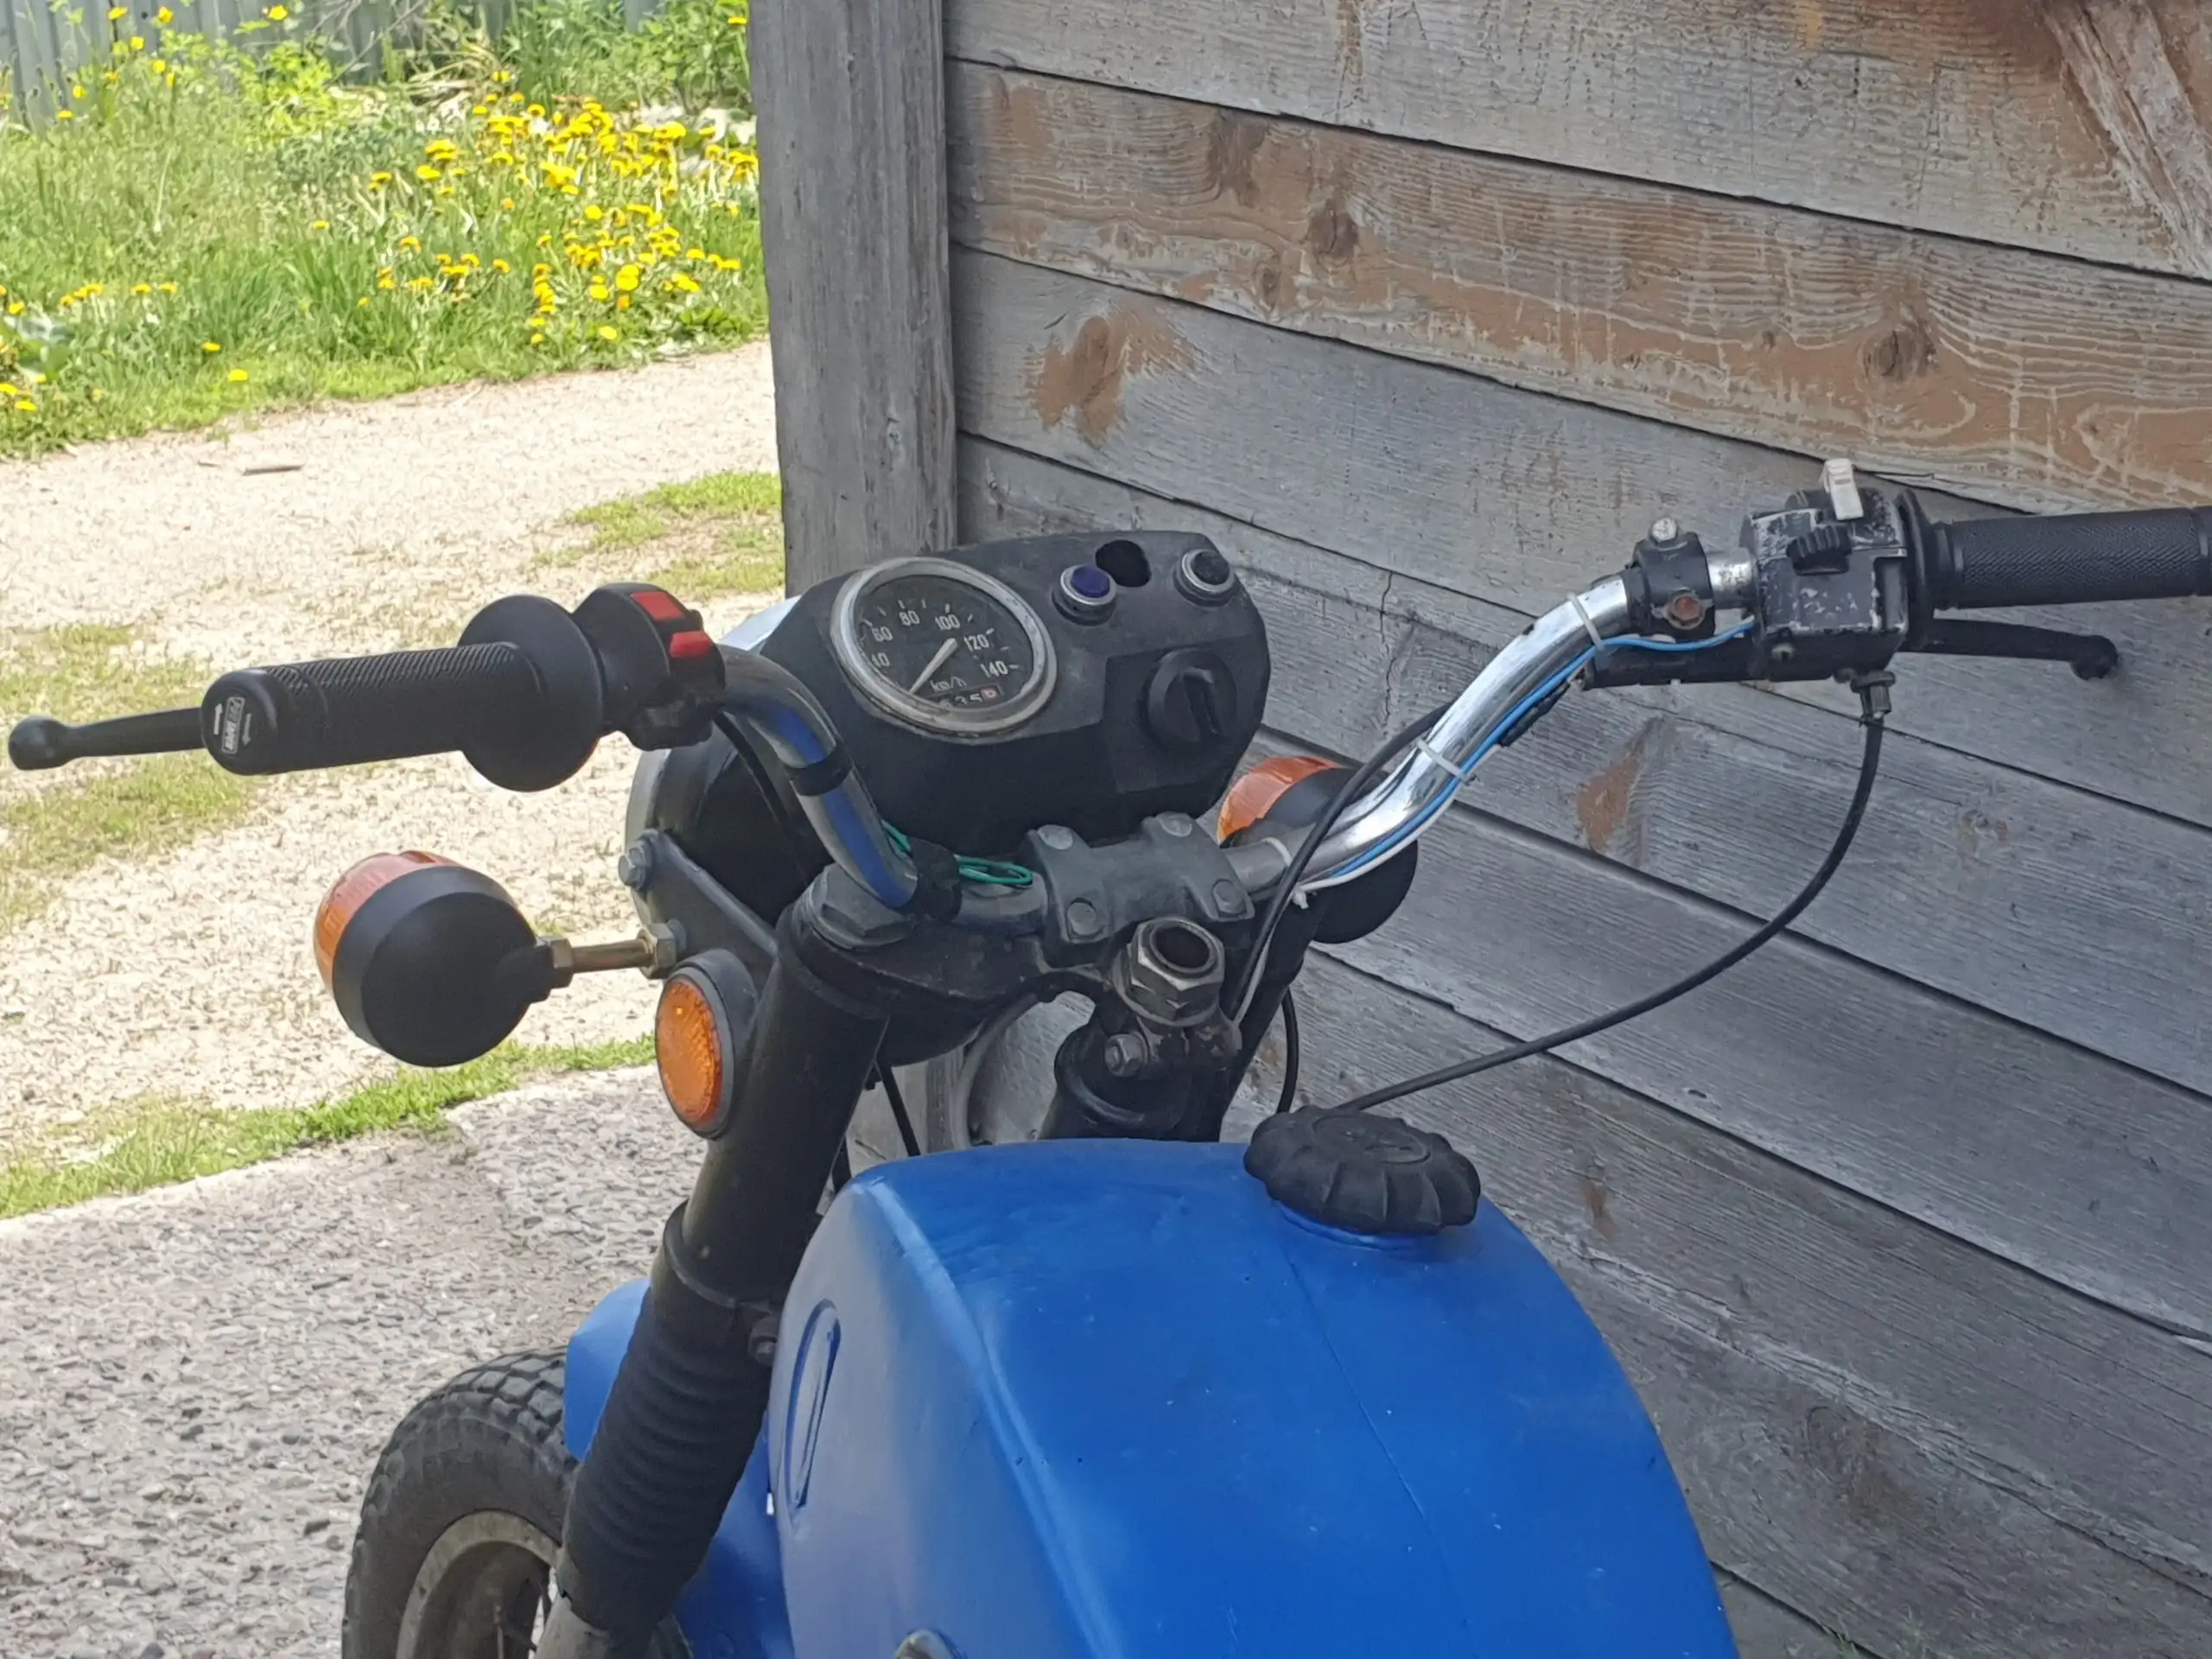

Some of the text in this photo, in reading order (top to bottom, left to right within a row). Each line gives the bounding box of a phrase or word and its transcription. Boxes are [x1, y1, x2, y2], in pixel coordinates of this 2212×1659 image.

[899, 610, 920, 626] 80
[935, 614, 961, 630] 100
[872, 626, 893, 642] 60
[963, 634, 990, 652] 120
[981, 660, 1009, 678] 140
